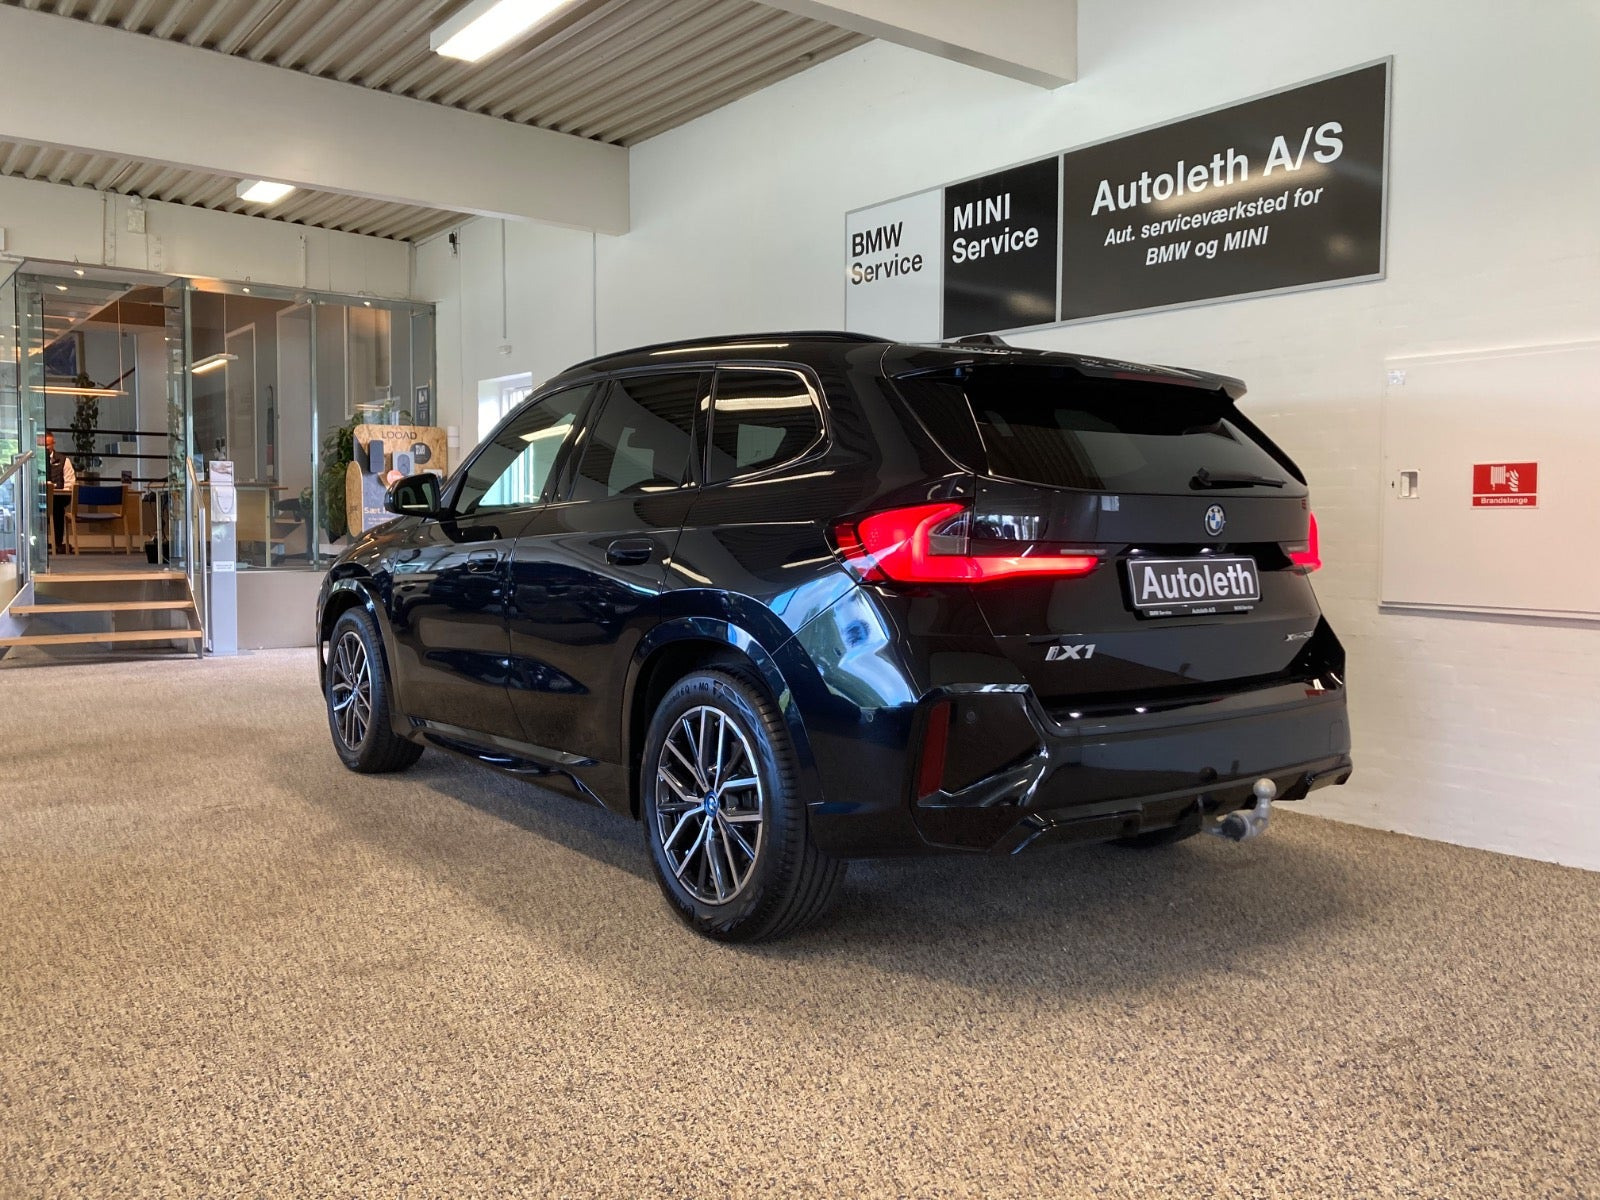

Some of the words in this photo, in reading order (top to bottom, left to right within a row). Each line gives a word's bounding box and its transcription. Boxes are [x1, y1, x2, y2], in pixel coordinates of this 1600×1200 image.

[1091, 148, 1249, 216] Autoleth
[1263, 121, 1344, 177] A/S
[953, 192, 1011, 233] MINI
[1104, 228, 1136, 247] Aut.
[1141, 191, 1289, 239] serviceværksted
[1293, 187, 1324, 208] for
[852, 221, 903, 258] BMW
[952, 226, 1039, 264] Service
[1146, 240, 1191, 266] BMW
[1195, 239, 1218, 260] og
[1224, 226, 1269, 251] MINI
[851, 253, 923, 286] Service
[1480, 497, 1529, 505] Brandslange
[1142, 563, 1255, 600] Autoleth
[1044, 644, 1096, 661] iX1
